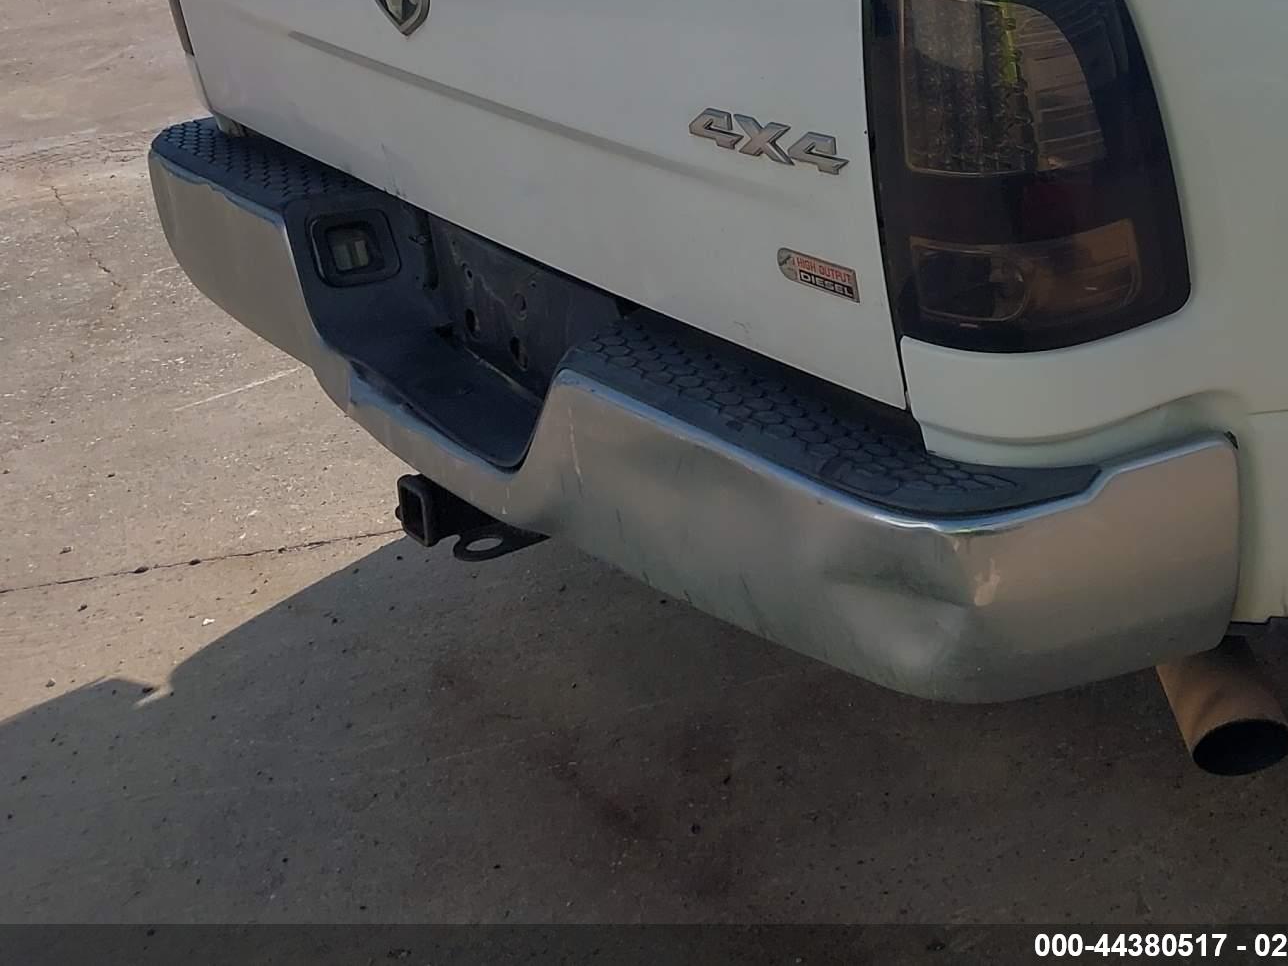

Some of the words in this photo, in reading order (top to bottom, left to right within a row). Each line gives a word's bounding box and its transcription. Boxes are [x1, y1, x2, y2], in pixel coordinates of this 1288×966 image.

[688, 108, 850, 175] 4X4
[797, 257, 816, 272] HIGH
[819, 265, 850, 284] OUTPUT
[800, 272, 853, 296] DIESEL
